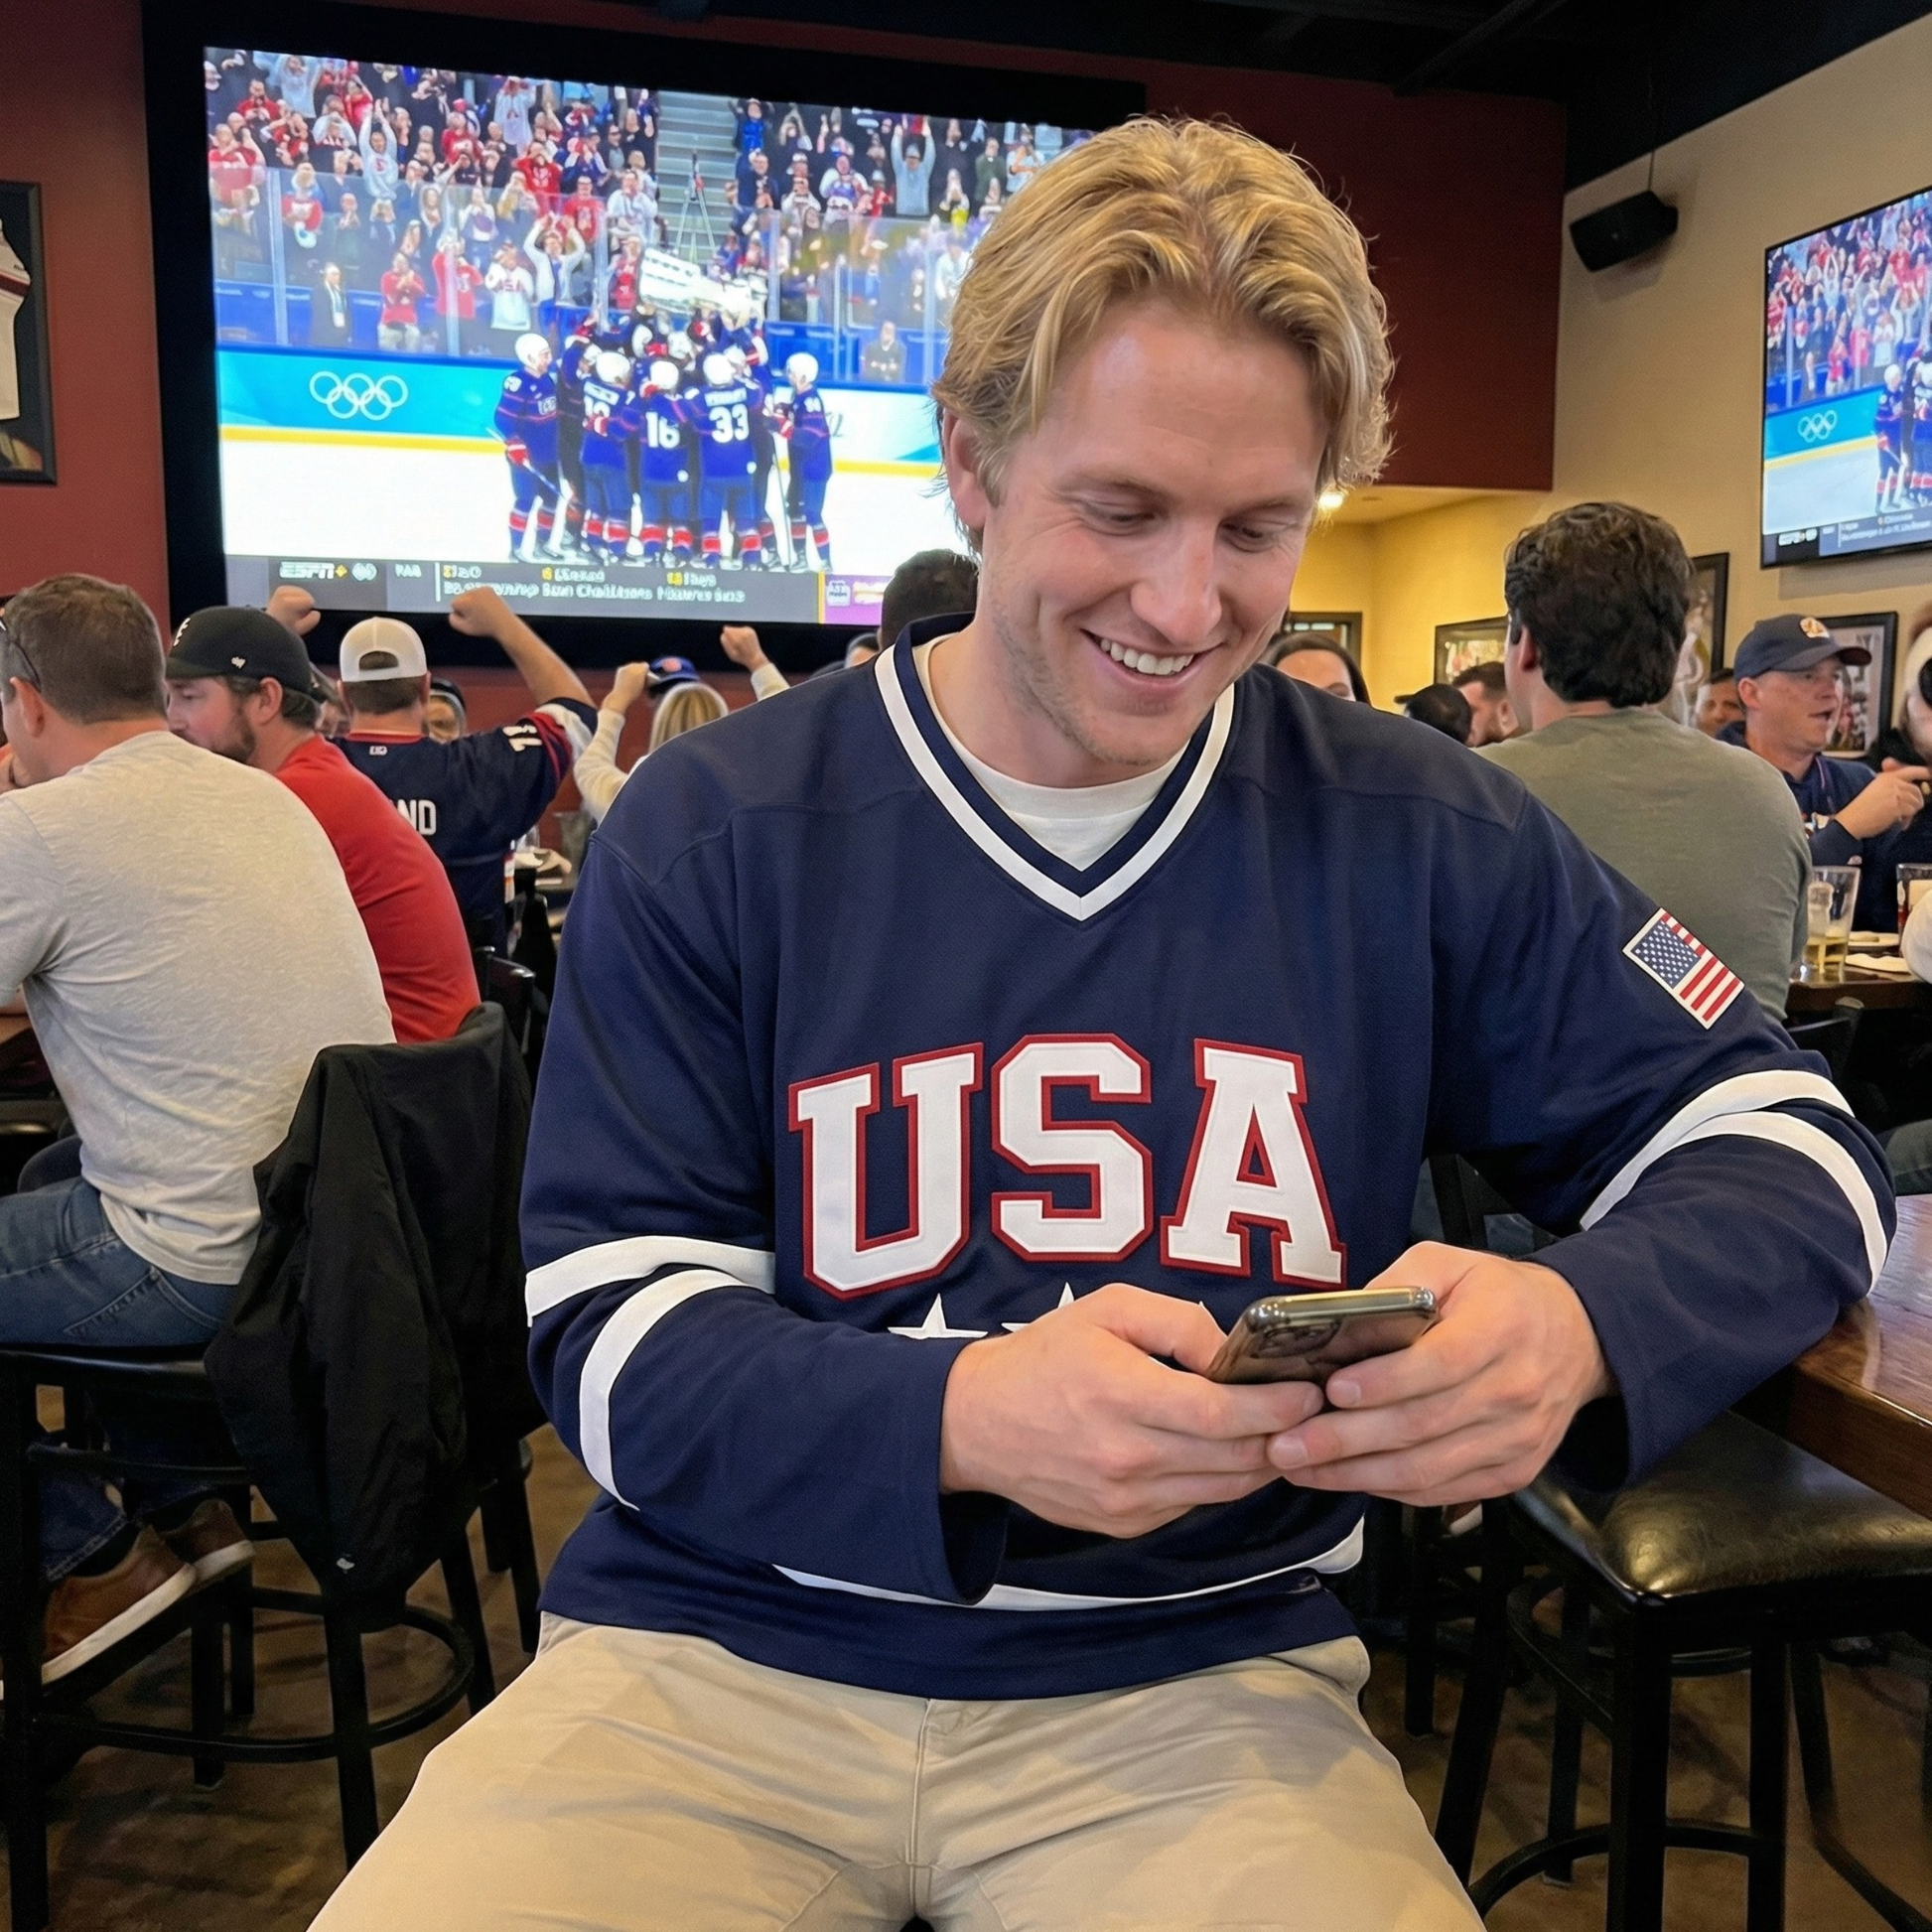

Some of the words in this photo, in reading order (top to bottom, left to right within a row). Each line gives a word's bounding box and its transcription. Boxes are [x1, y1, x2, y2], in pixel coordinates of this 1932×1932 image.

[645, 411, 680, 449] 16
[709, 403, 750, 443] 33
[788, 1033, 1347, 1301] USA
